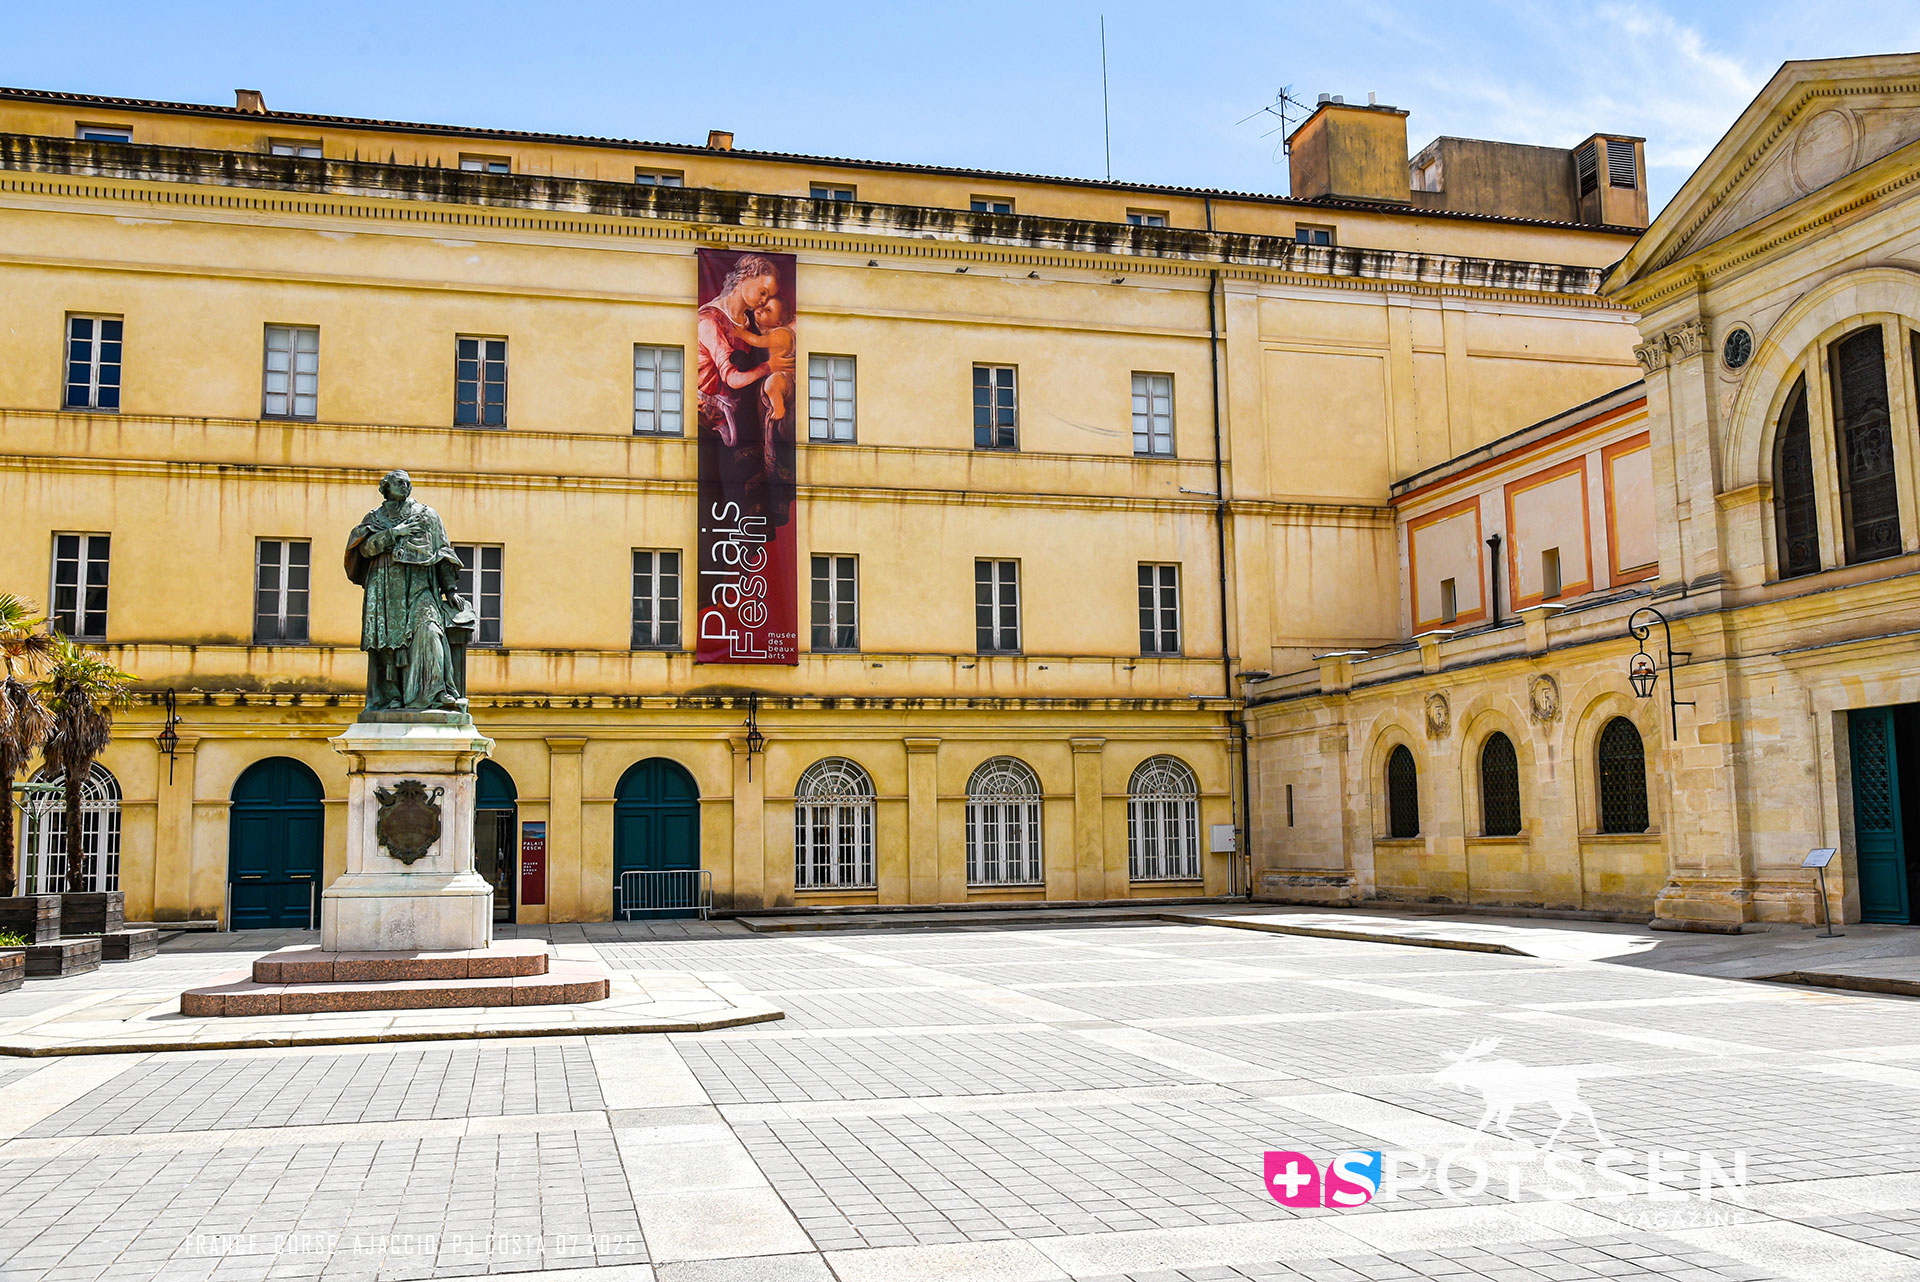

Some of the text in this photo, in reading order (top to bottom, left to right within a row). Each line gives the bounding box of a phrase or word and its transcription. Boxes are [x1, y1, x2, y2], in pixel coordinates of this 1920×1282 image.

[701, 502, 740, 639] Palais
[729, 516, 768, 659] Fesch
[768, 638, 783, 646] des
[768, 645, 795, 653] beaux
[768, 652, 786, 660] arts
